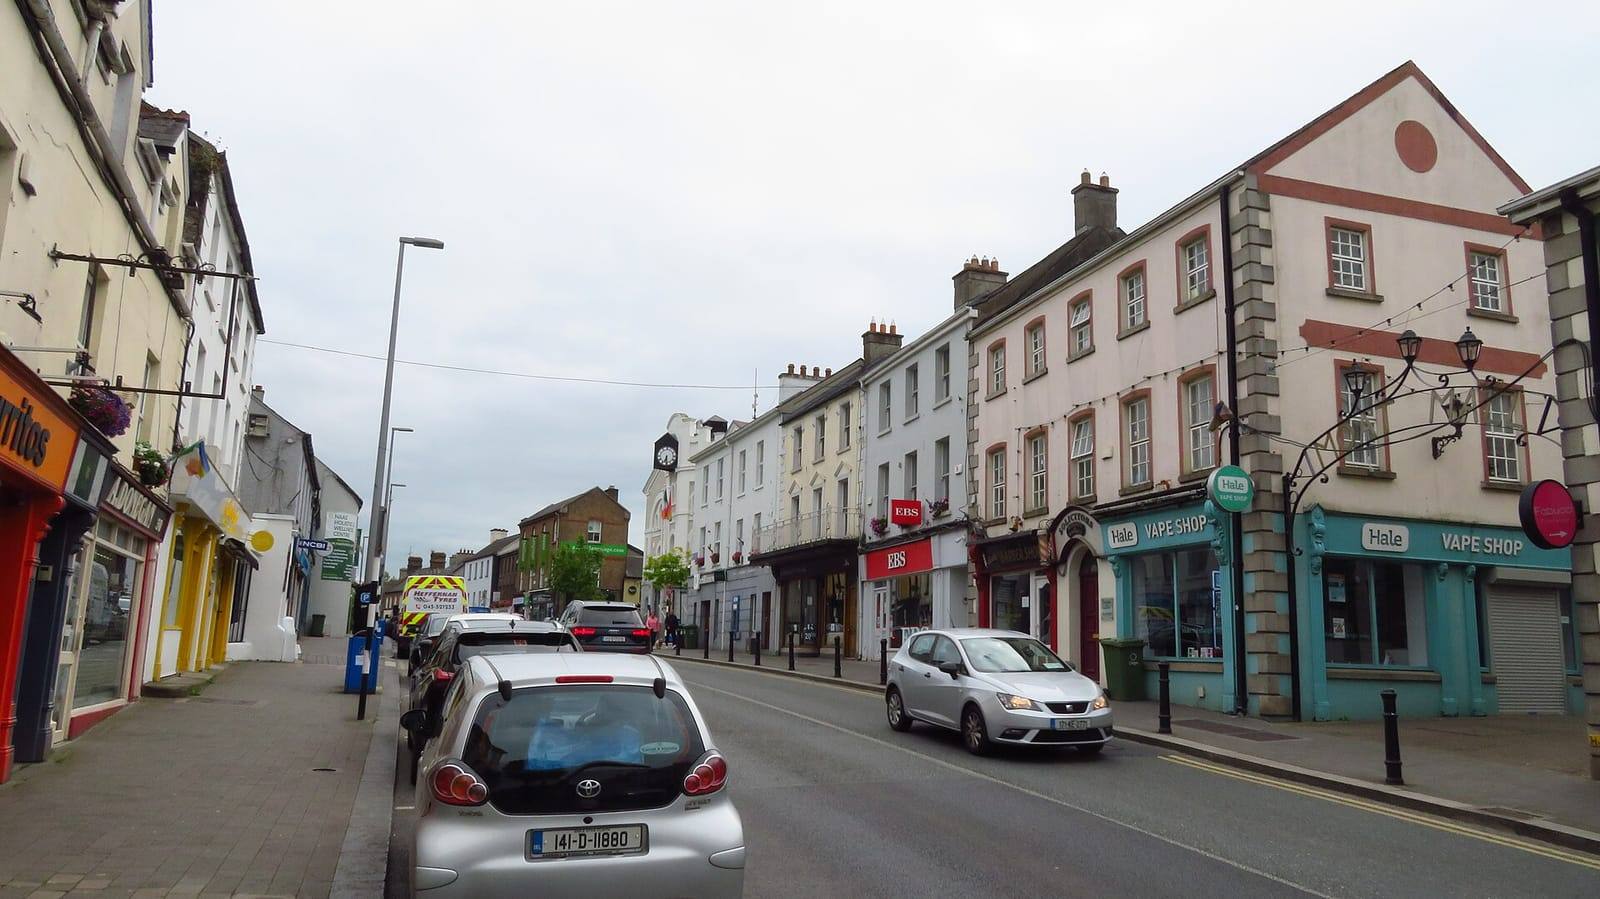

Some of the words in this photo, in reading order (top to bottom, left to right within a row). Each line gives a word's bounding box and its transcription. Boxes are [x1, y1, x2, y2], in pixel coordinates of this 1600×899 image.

[1222, 479, 1244, 490] Hale
[895, 507, 919, 517] EBS
[1112, 528, 1134, 544] Hale
[1144, 519, 1174, 540] VAPE
[1175, 514, 1207, 536] SHOP
[302, 541, 326, 550] NCBI
[1369, 528, 1403, 547] Hale
[1441, 532, 1481, 553] VAPE
[1483, 537, 1524, 557] SHOP
[887, 550, 906, 570] EBS
[414, 590, 458, 598] HEFFERNAN
[554, 831, 628, 851] 141-D-11880
